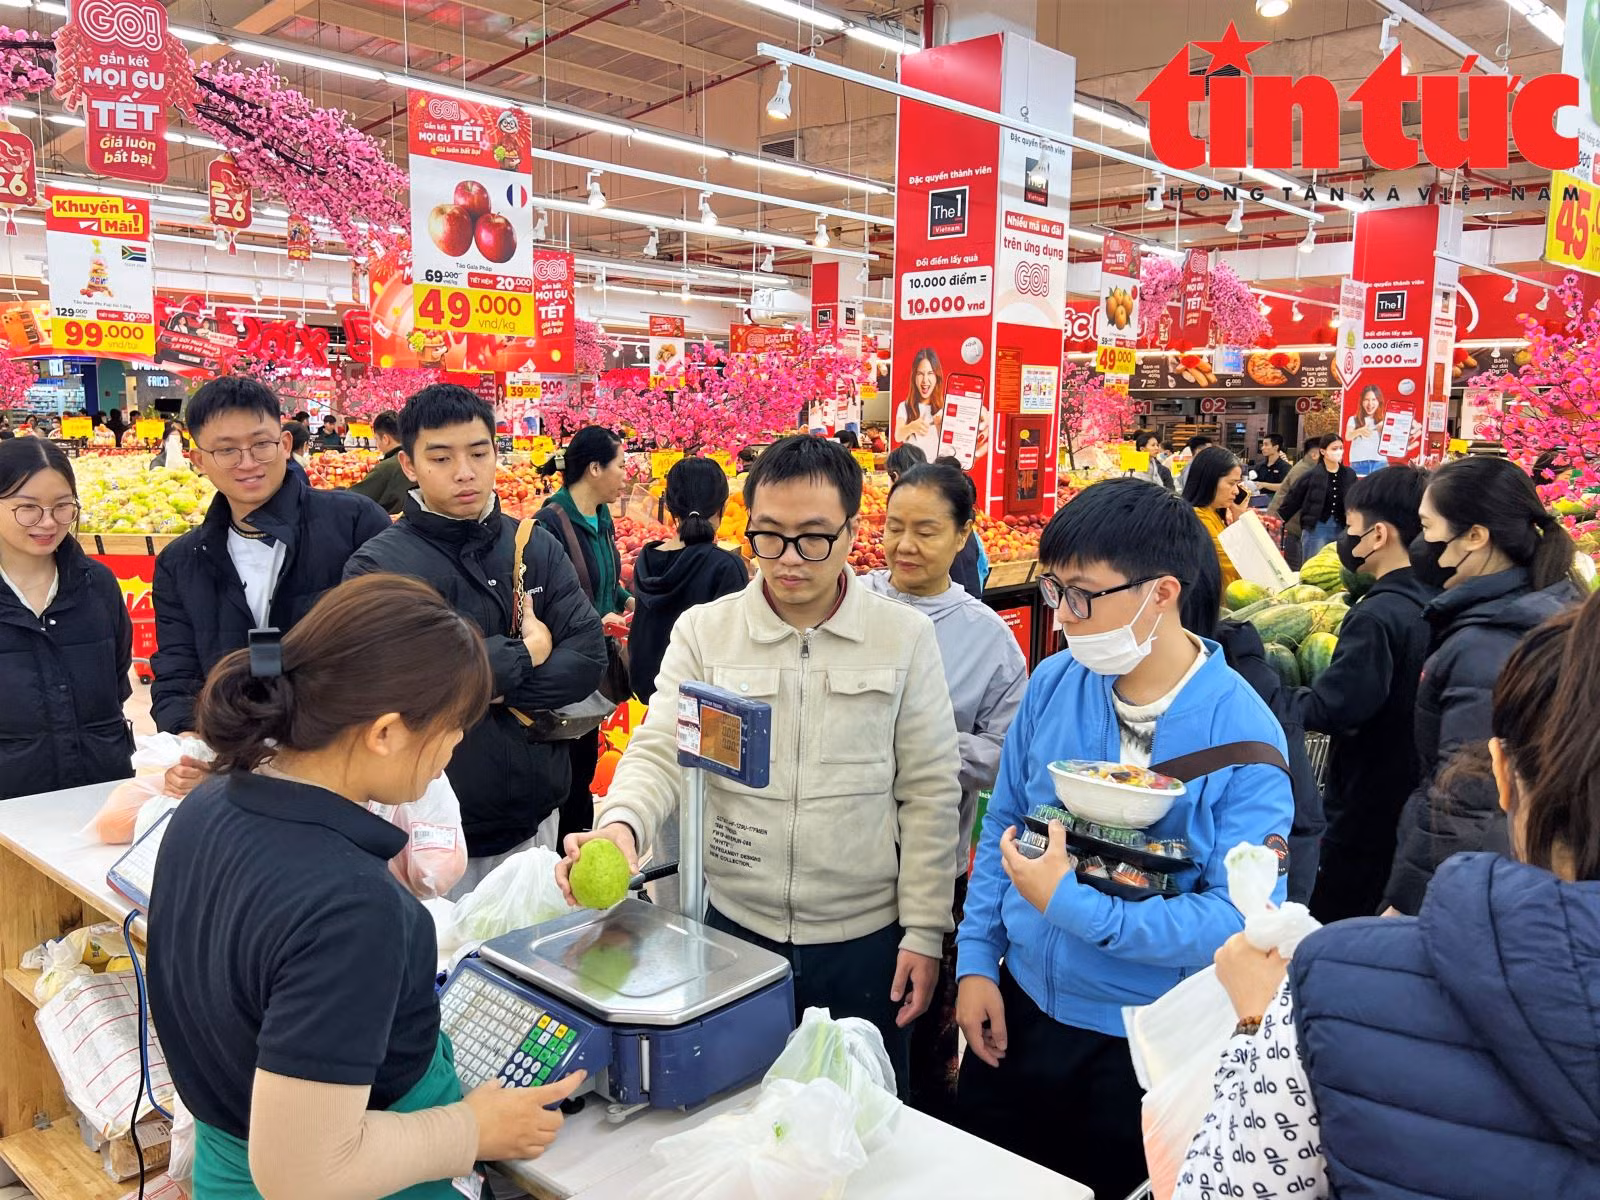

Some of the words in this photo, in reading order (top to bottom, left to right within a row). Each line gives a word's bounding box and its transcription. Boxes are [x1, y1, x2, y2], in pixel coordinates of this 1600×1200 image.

[78, 0, 163, 51] GO!
[99, 51, 125, 66] gắn
[128, 54, 149, 67] kết
[83, 66, 127, 90] MỌI
[131, 70, 165, 91] GU
[91, 91, 160, 131] TẾT
[428, 99, 460, 121] GO!
[418, 131, 436, 143] MỌI
[437, 133, 451, 143] GU
[450, 119, 484, 142] TẾT
[100, 134, 123, 149] Giá
[125, 136, 156, 151] luôn
[104, 149, 129, 164] bất
[131, 151, 152, 167] bại
[908, 176, 923, 186] Đặc
[925, 171, 949, 183] quyền
[950, 168, 973, 178] thành
[975, 166, 992, 175] viên
[55, 199, 119, 215] Khuyến
[215, 200, 246, 222] 26
[935, 225, 961, 233] Vietnam
[1007, 214, 1028, 228] Nhiều
[1029, 220, 1040, 232] mã
[1051, 223, 1062, 236] đãi
[1003, 236, 1022, 251] trên
[1024, 239, 1041, 256] ứng
[1042, 243, 1064, 261] dụng
[534, 259, 567, 281] GO!
[916, 257, 928, 267] Đổi
[930, 256, 949, 266] điểm
[950, 254, 962, 265] lấy
[495, 276, 532, 290] 20.000
[909, 276, 947, 289] 10.000
[949, 272, 977, 286] điểm
[1015, 260, 1050, 297] GO!
[535, 291, 553, 301] MỌI
[554, 290, 568, 299] GU
[907, 295, 965, 315] 10.000
[967, 300, 986, 311] vnd
[1186, 292, 1202, 310] TẾT
[418, 288, 522, 329] 49.000
[538, 300, 566, 319] TẾT
[64, 321, 144, 347] 99.000
[478, 318, 516, 332] vnd/kg
[1390, 340, 1411, 349] điểm
[1200, 397, 1227, 414] 02
[1296, 397, 1323, 413] 03
[1267, 1040, 1290, 1060] alo
[1254, 1074, 1277, 1094] alo
[1286, 1077, 1306, 1107] alo
[1243, 1110, 1266, 1129] alo
[1275, 1112, 1298, 1141] alo
[1232, 1144, 1256, 1163] alo
[1264, 1147, 1288, 1176] alo
[1218, 1176, 1244, 1198] alo
[1252, 1182, 1277, 1200] al
[1287, 1174, 1316, 1194] alo
